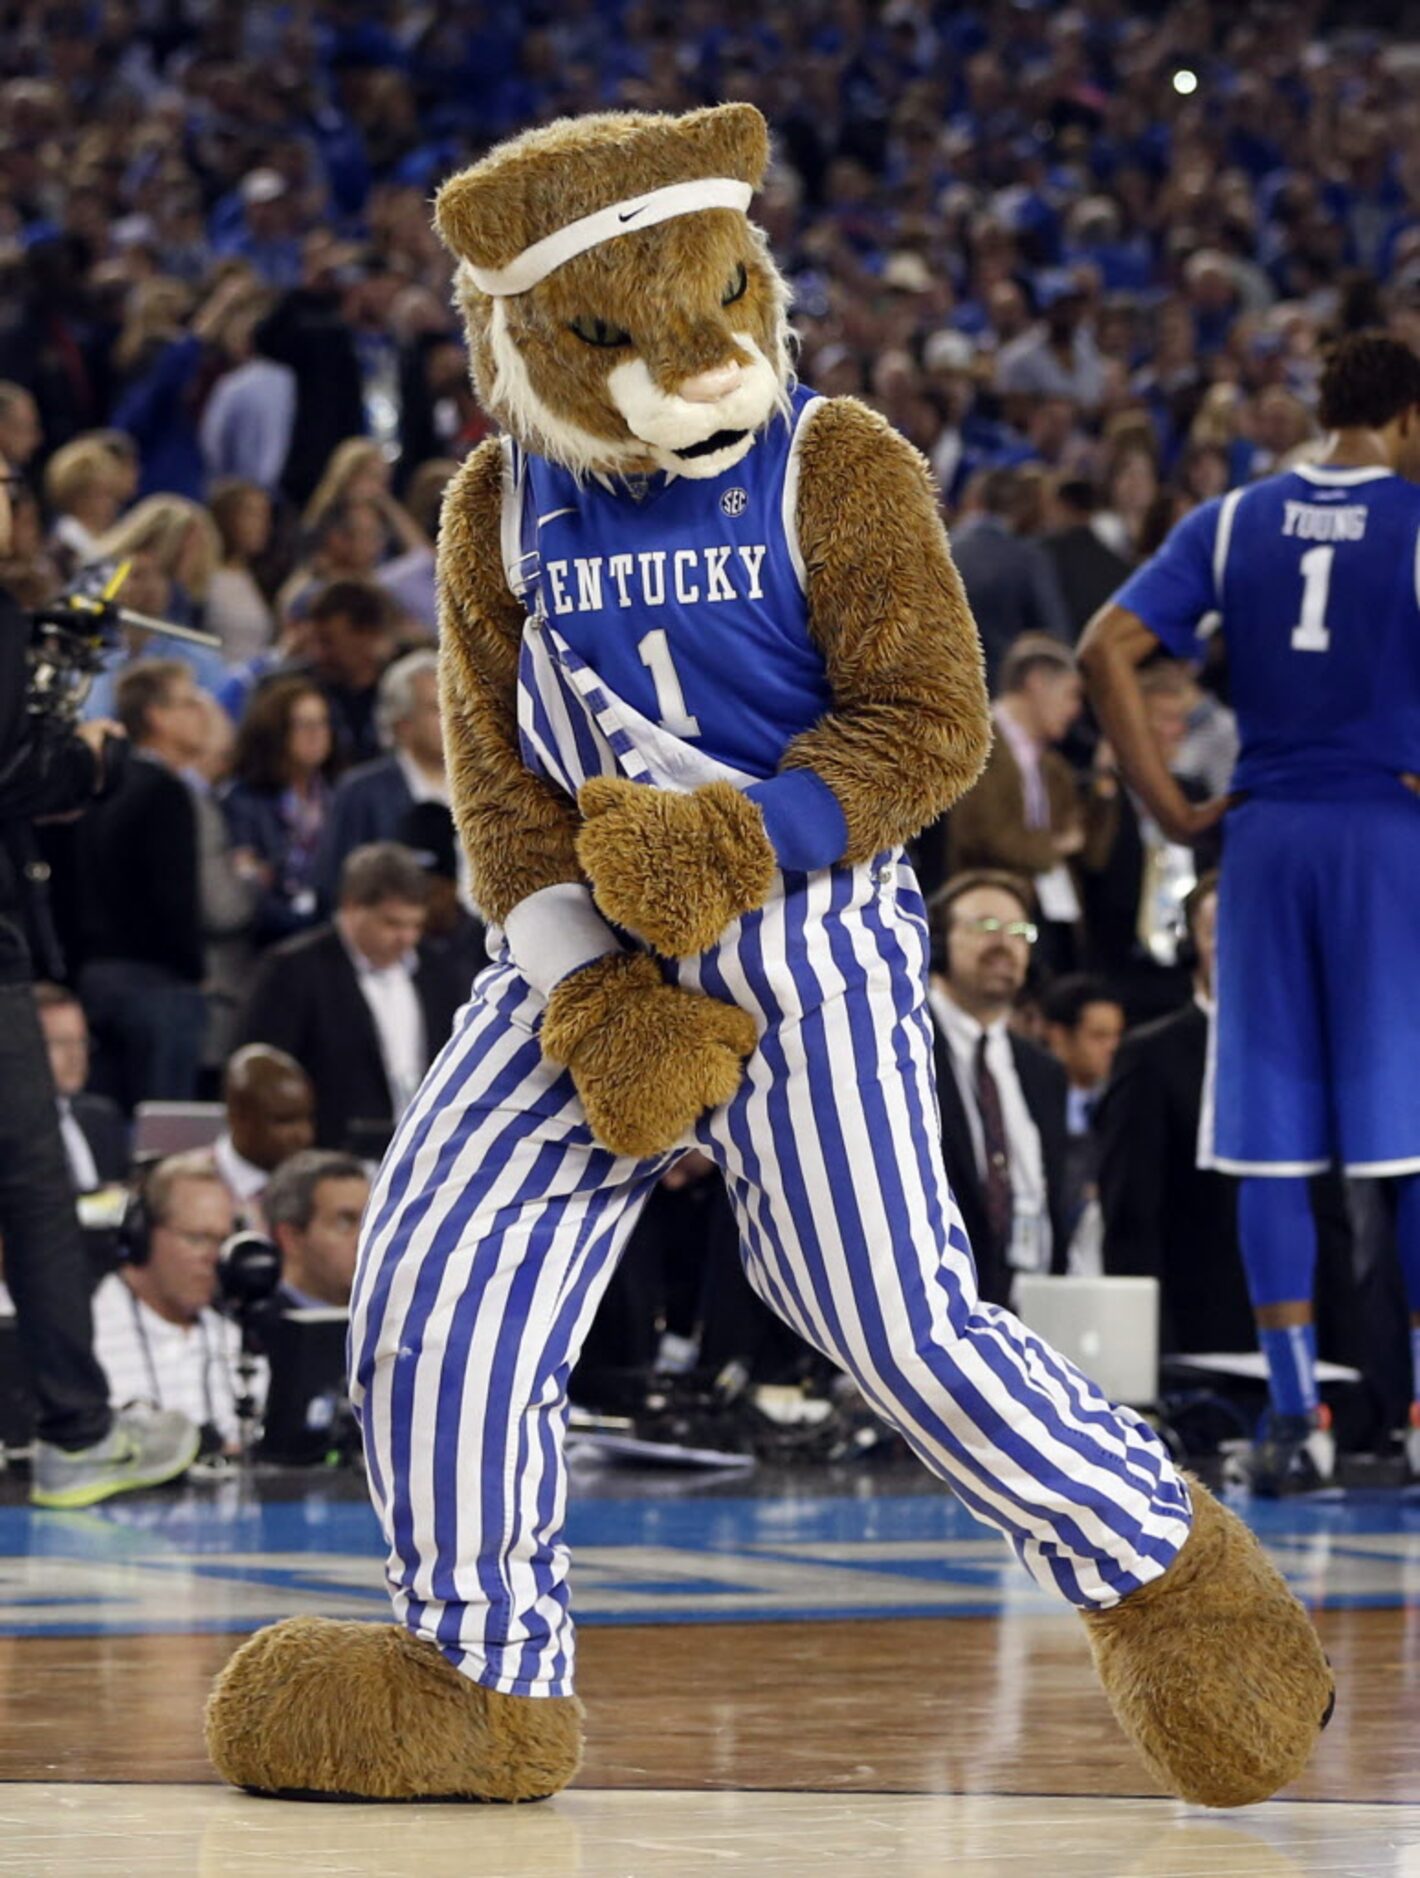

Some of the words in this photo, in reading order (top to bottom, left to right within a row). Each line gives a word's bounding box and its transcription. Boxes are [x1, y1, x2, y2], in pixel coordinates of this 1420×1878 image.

[724, 491, 746, 514] SEC
[1282, 500, 1368, 541] YOUNG
[535, 545, 766, 618] ENTUCKY
[1291, 545, 1335, 652] 1
[638, 628, 701, 737] 1
